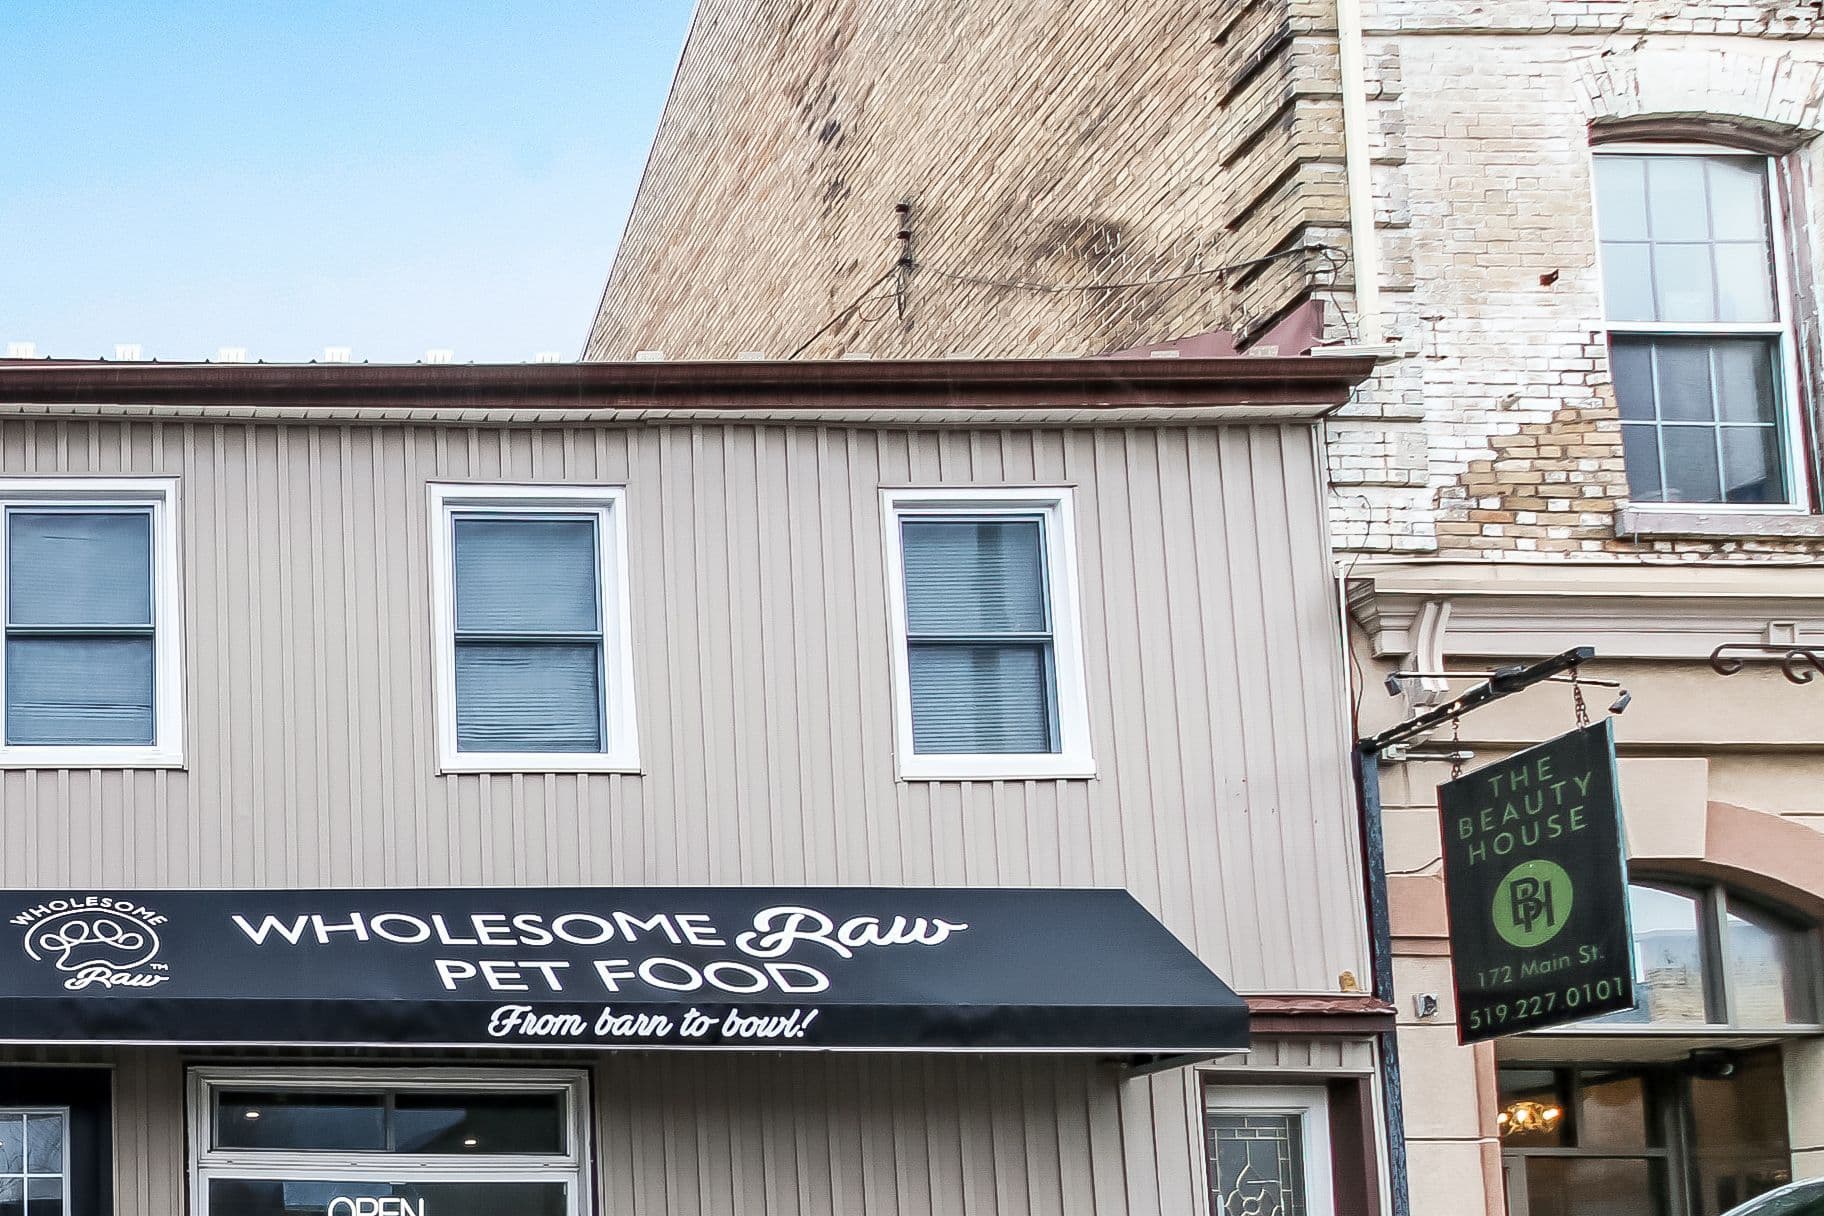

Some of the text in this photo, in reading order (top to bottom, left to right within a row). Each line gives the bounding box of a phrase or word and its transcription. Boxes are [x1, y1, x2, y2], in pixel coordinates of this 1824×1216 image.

[1488, 757, 1553, 797] THE
[1459, 771, 1592, 839] BEAUTY
[1468, 805, 1588, 865] HOUSE
[9, 896, 169, 926] WHOLESOME
[231, 906, 969, 959] WHOLESOME Raw
[64, 966, 170, 990] Raw
[434, 957, 830, 994] PET FOOD
[1478, 944, 1605, 988] 172 Main St.
[487, 1005, 819, 1038] From barn to bowl!
